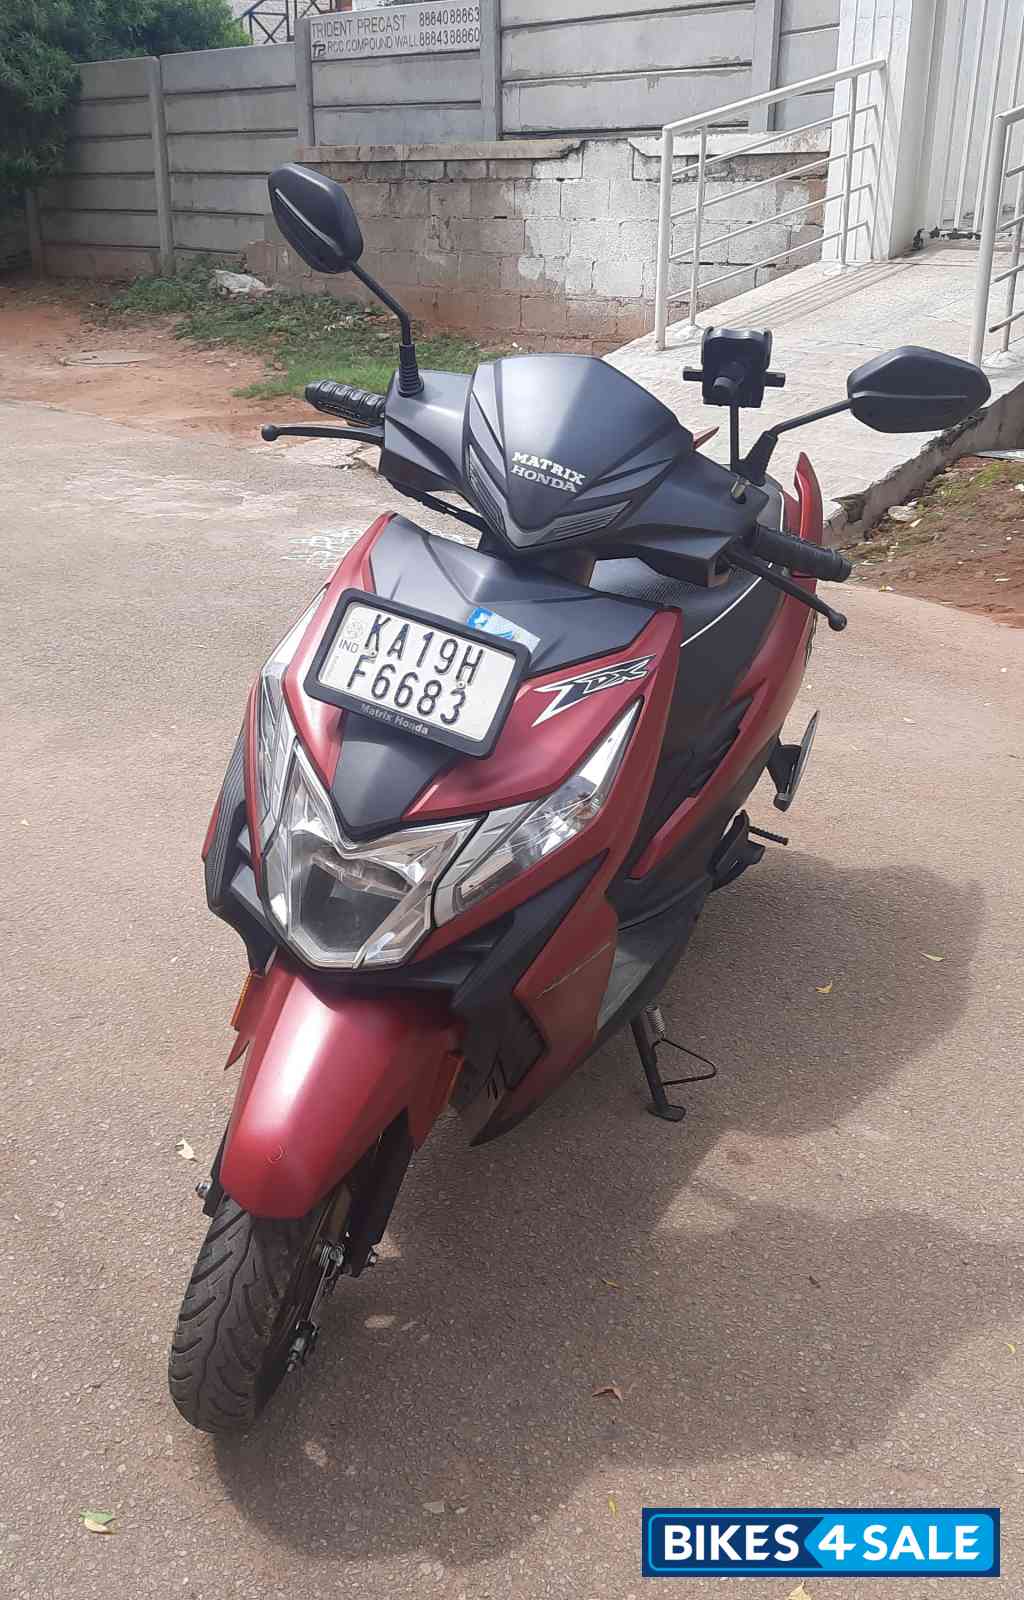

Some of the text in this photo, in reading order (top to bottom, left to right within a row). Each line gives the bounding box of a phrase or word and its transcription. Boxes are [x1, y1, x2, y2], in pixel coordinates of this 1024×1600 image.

[311, 14, 407, 39] TRIDENT PRECAST
[419, 6, 480, 27] 8884088863
[419, 27, 480, 46] 8884388860
[511, 464, 577, 493] HONDA
[512, 451, 586, 486] MATRIX
[364, 613, 484, 687] KA19H
[346, 653, 467, 725] F6683
[360, 703, 429, 735] Matrix Honda
